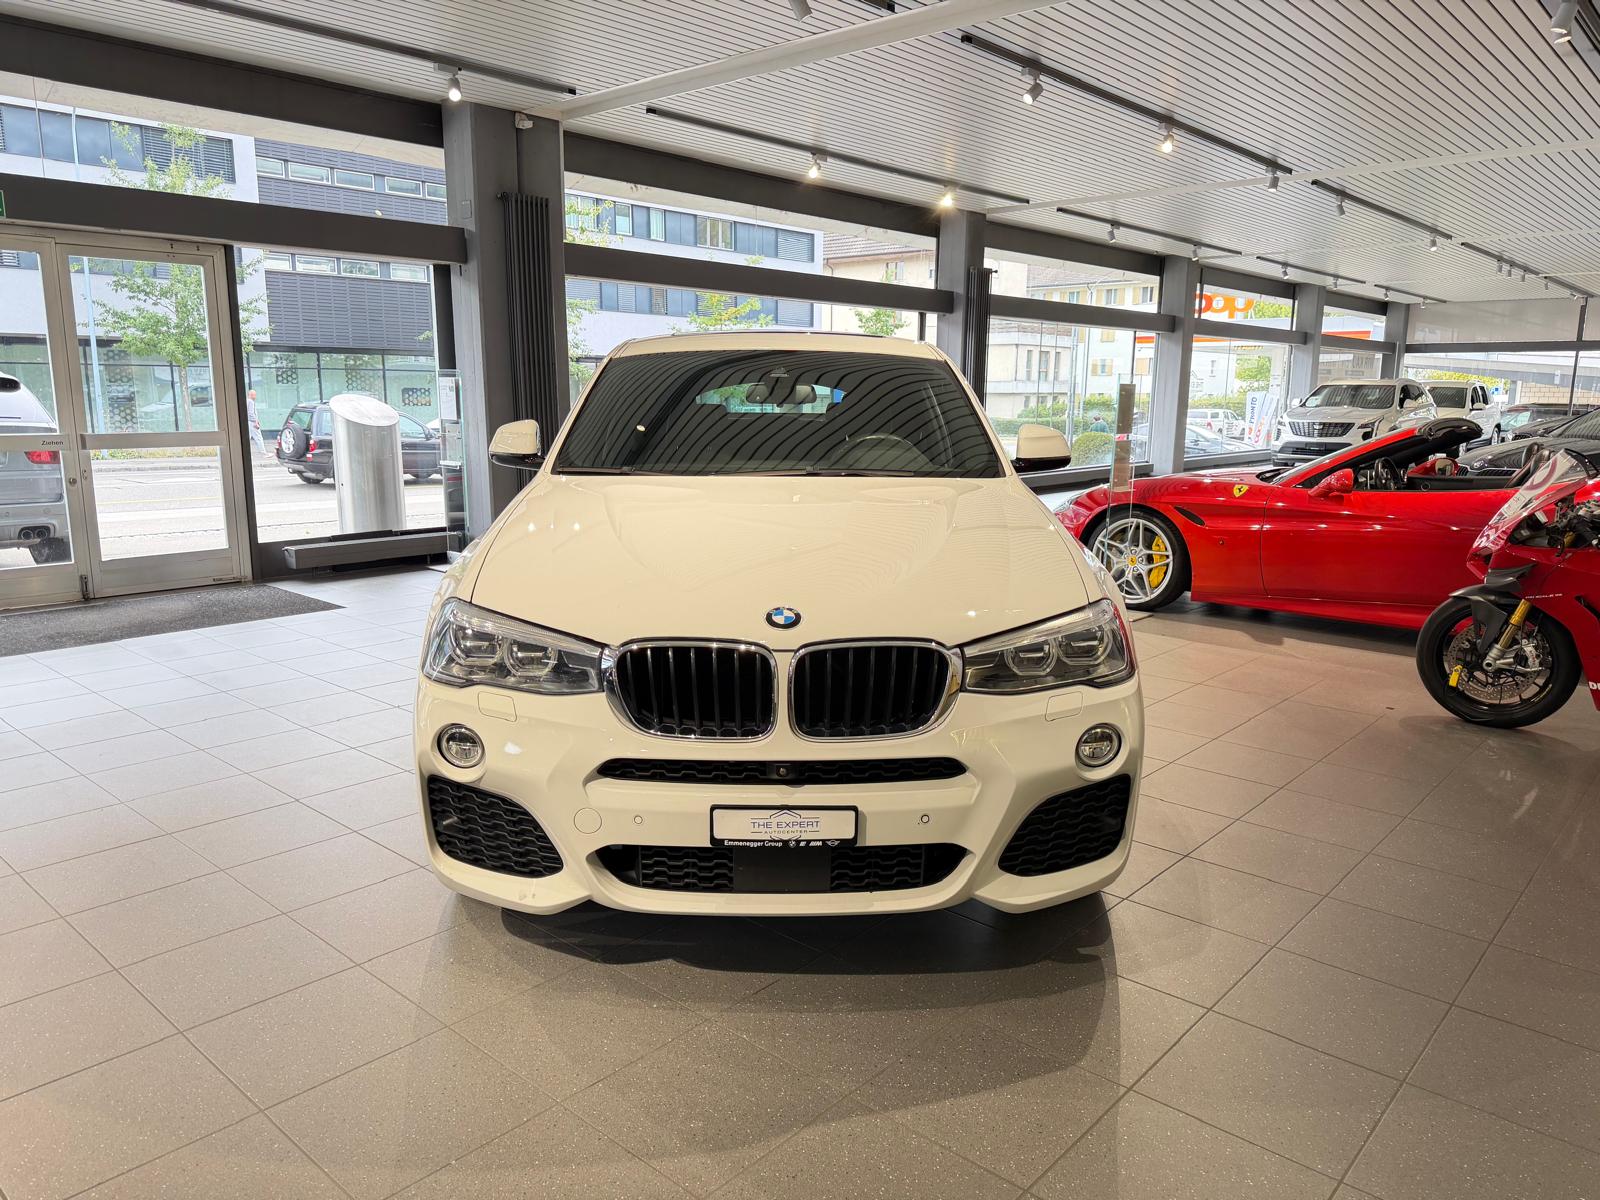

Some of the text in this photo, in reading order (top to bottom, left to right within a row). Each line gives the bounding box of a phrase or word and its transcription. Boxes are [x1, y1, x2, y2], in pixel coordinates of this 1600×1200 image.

[1195, 293, 1255, 319] oop
[751, 820, 820, 829] THE EXPERT
[724, 840, 763, 848] Emmenegger
[764, 840, 783, 848] Group
